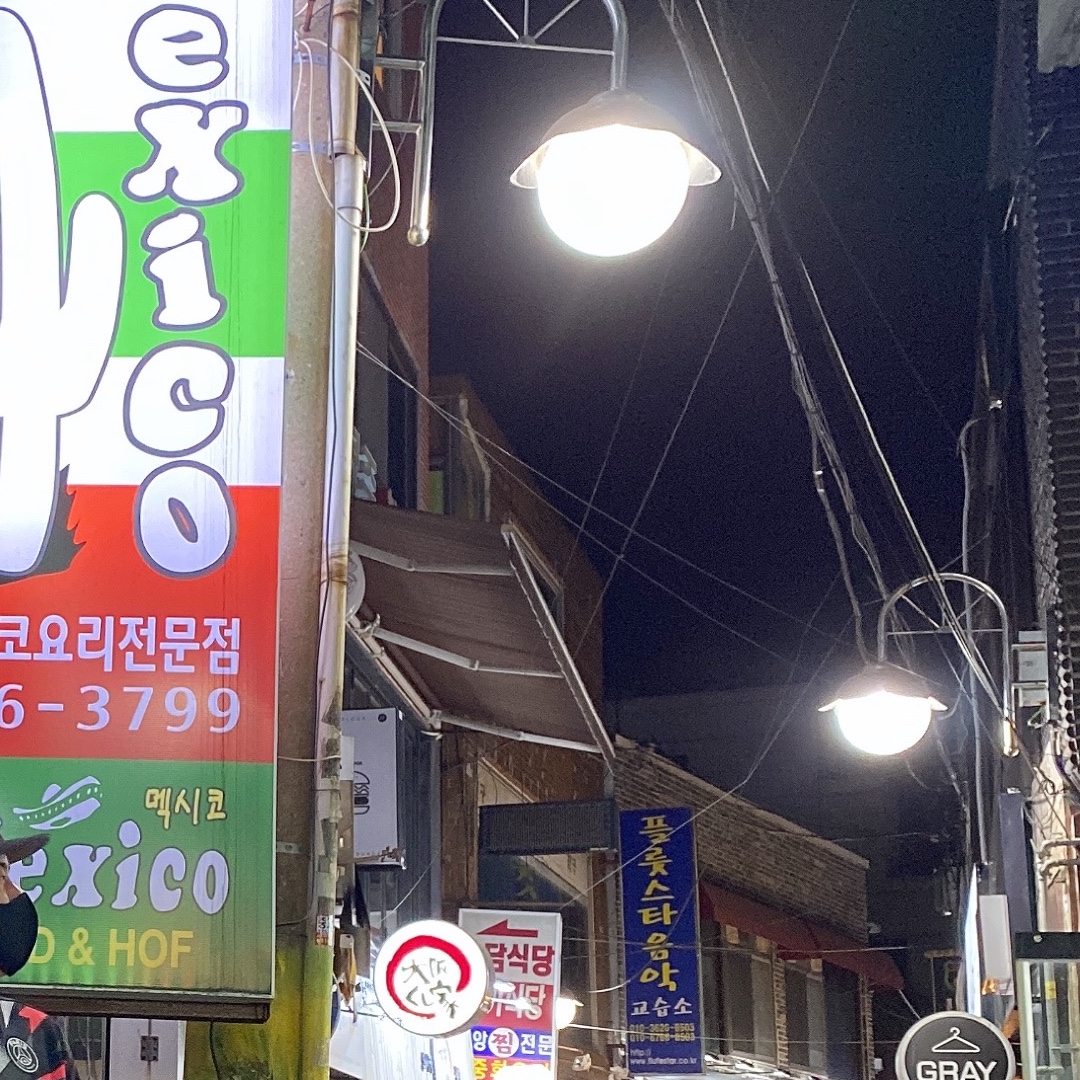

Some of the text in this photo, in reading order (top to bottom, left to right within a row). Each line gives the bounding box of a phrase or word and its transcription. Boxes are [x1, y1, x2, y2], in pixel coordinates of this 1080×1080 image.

[144, 787, 227, 830] 멕시코
[6, 820, 230, 915] exico
[108, 929, 195, 971] HOF
